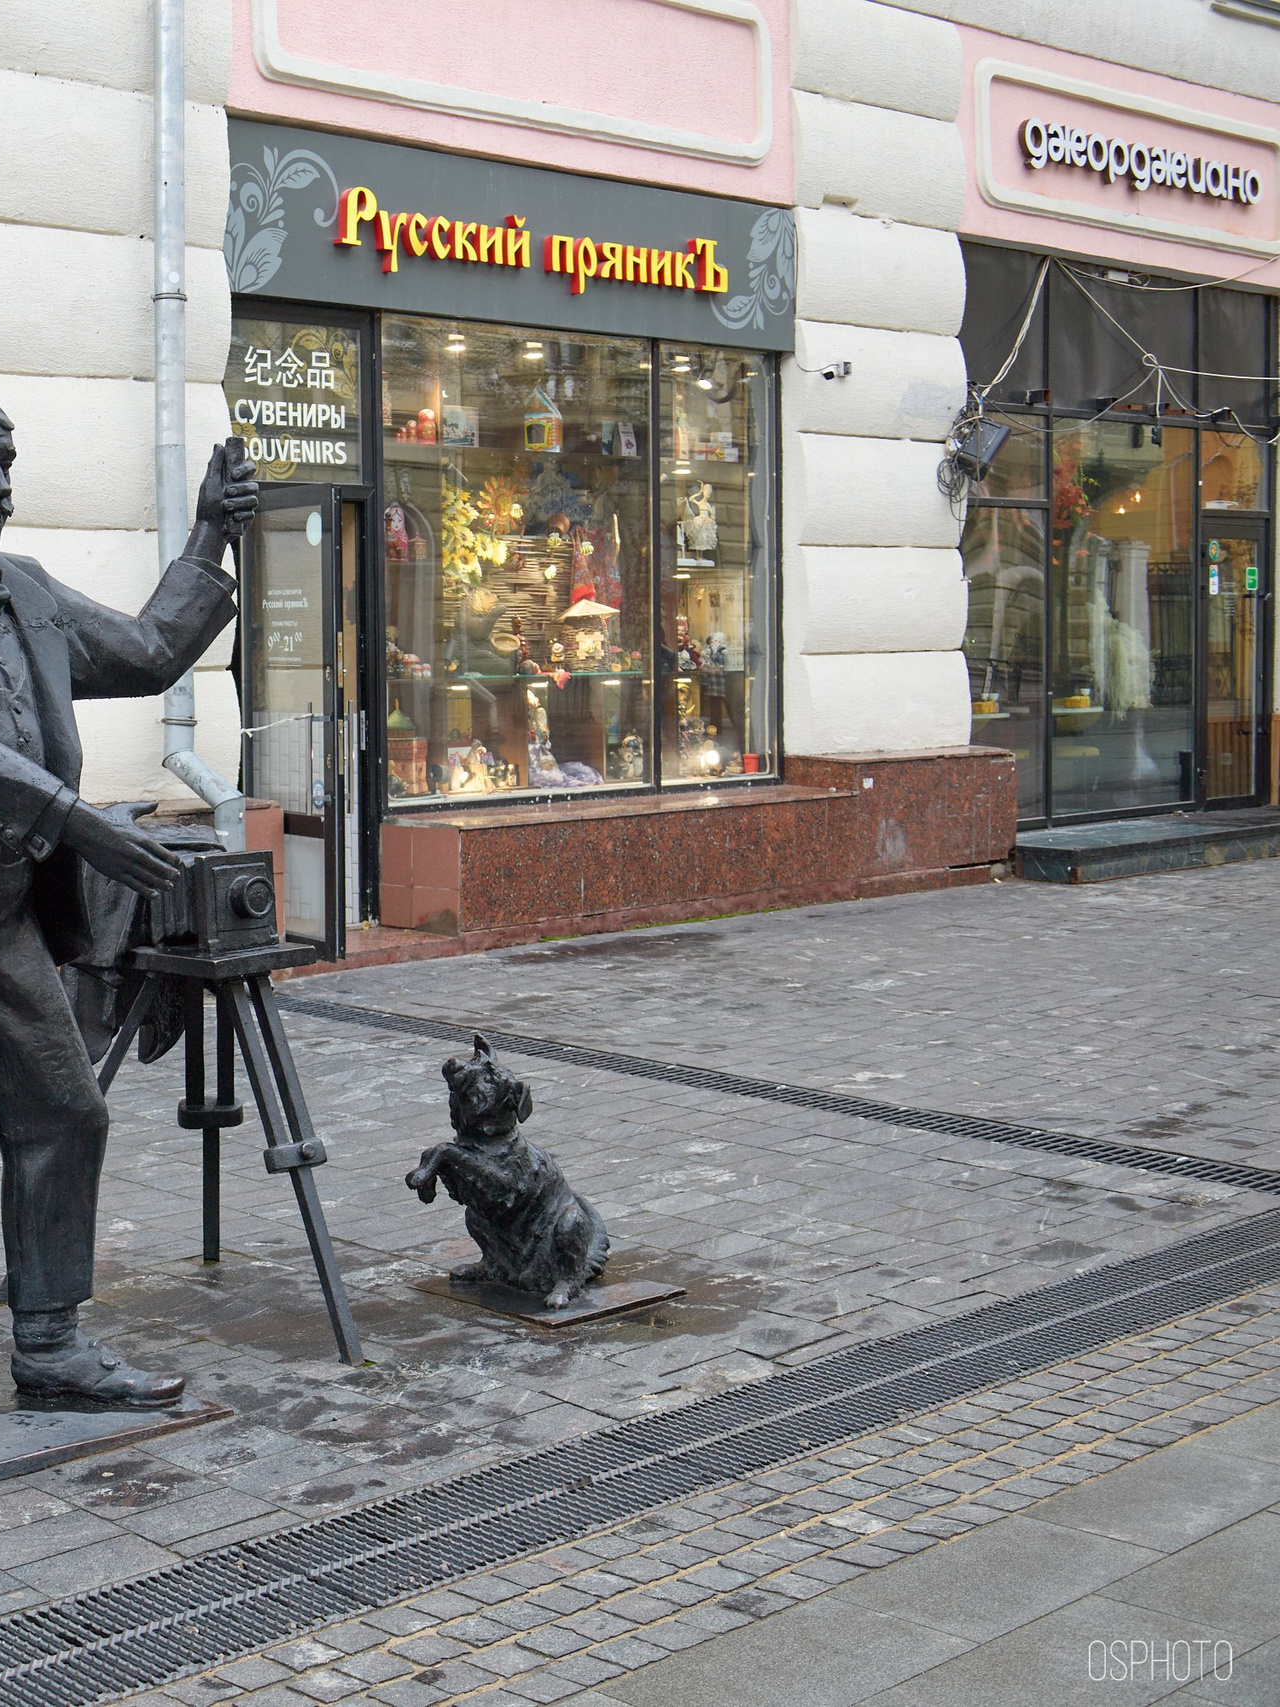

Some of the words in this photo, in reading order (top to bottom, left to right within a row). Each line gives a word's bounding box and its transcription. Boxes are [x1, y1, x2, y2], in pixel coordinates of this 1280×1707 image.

[332, 185, 532, 273] Русский
[542, 235, 729, 295] пряникЪ
[243, 345, 335, 389] 纪念品
[234, 398, 346, 429] СУВЕНИРЫ
